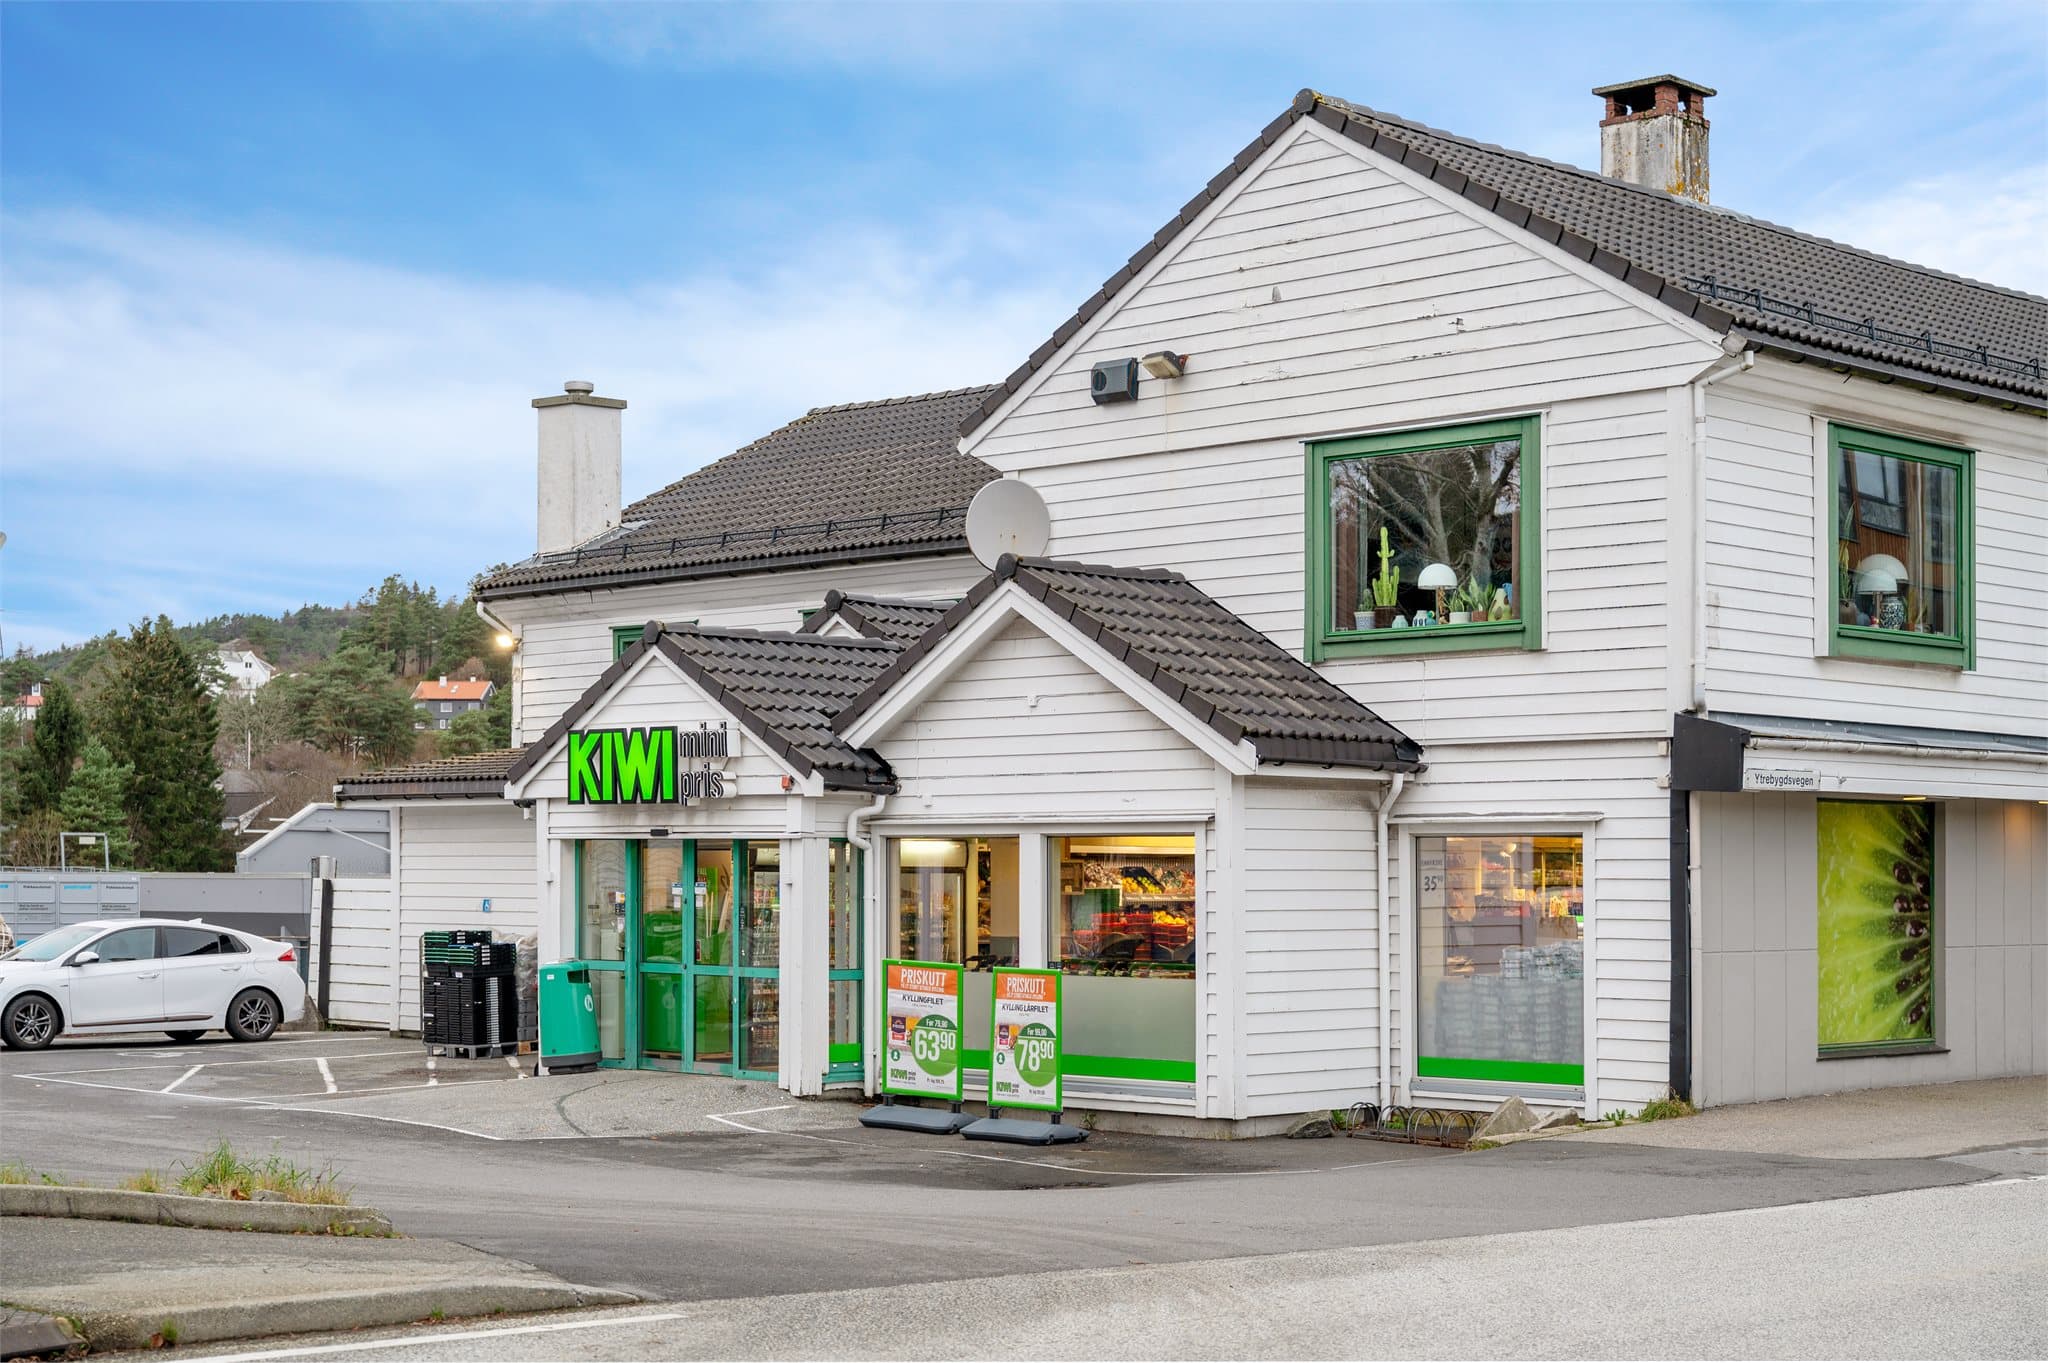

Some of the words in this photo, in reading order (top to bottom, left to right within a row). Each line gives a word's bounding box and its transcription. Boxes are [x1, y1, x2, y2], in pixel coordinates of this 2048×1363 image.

[679, 722, 728, 757] mini
[568, 726, 679, 805] KIWI
[681, 762, 724, 806] pris
[1754, 773, 1814, 787] Ytrebygdsvegen
[901, 968, 947, 986] PRISKUTT
[902, 994, 944, 1005] KYLLINGFILET
